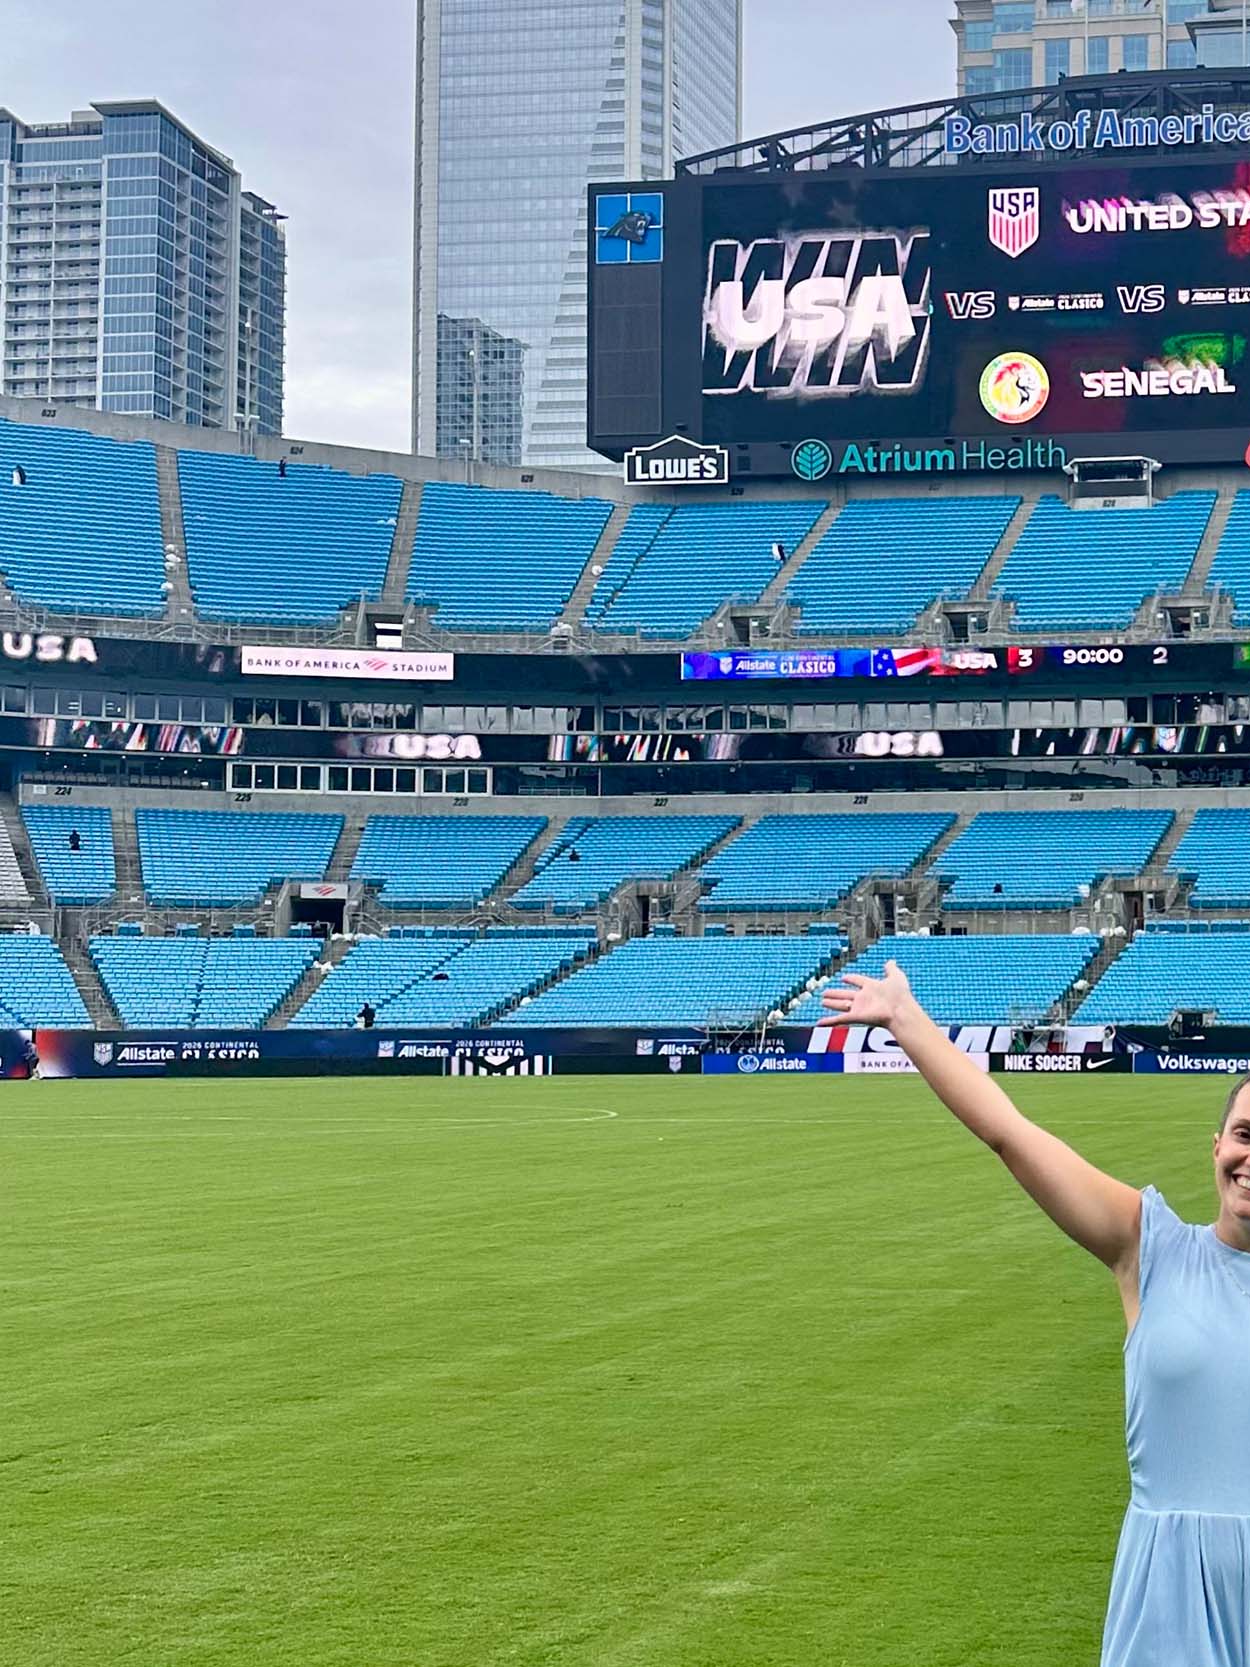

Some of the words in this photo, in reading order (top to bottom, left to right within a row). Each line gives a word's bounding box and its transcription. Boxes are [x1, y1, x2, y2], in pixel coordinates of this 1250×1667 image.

[944, 113, 1045, 154] Bank
[1048, 109, 1090, 149] of
[993, 193, 1034, 218] USA
[1068, 203, 1193, 233] UNITED
[945, 290, 996, 320] VS
[1116, 285, 1165, 313] VS
[712, 275, 916, 347] USA
[1080, 366, 1236, 398] SENEGAL
[838, 442, 954, 474] Atrium
[961, 438, 1066, 470] Health
[635, 454, 719, 480] LOWE'S
[2, 631, 98, 664] USA
[1062, 648, 1124, 665] 90:00
[1152, 646, 1168, 665] 2
[247, 657, 281, 669] BANK
[285, 658, 302, 669] OF
[304, 659, 361, 671] AMERICA
[392, 662, 448, 674] STADIUM
[735, 659, 776, 671] Allstate
[953, 652, 998, 670] USA
[1017, 648, 1033, 667] 3
[54, 786, 73, 797] 224
[234, 793, 252, 802] 225
[117, 1047, 176, 1062] Allstate
[398, 1045, 449, 1058] Allstate
[759, 1057, 807, 1071] Allstate
[861, 1060, 887, 1068] BANK
[1004, 1055, 1033, 1071] NIKE
[1035, 1054, 1081, 1071] SOCCER
